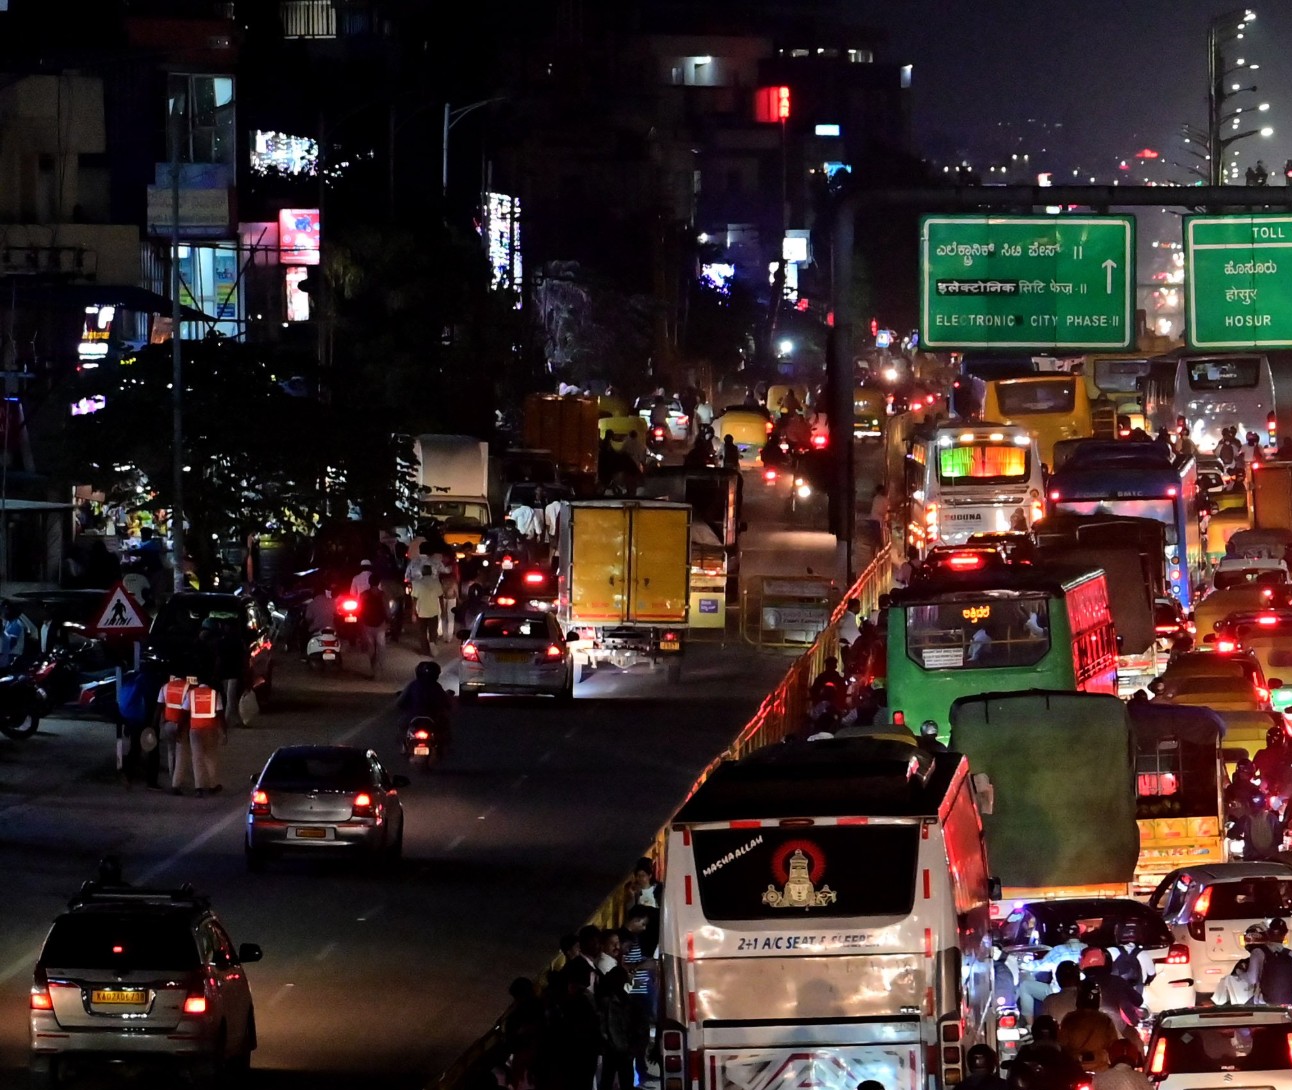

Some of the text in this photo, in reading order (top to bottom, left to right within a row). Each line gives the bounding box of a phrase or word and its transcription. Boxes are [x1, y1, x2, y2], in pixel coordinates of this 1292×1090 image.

[1252, 227, 1285, 239] TOLL
[1224, 259, 1277, 275] ಹೊಸೂರು
[1030, 315, 1058, 326] CITY
[1225, 315, 1271, 326] HOSUR
[762, 937, 783, 950] A/C
